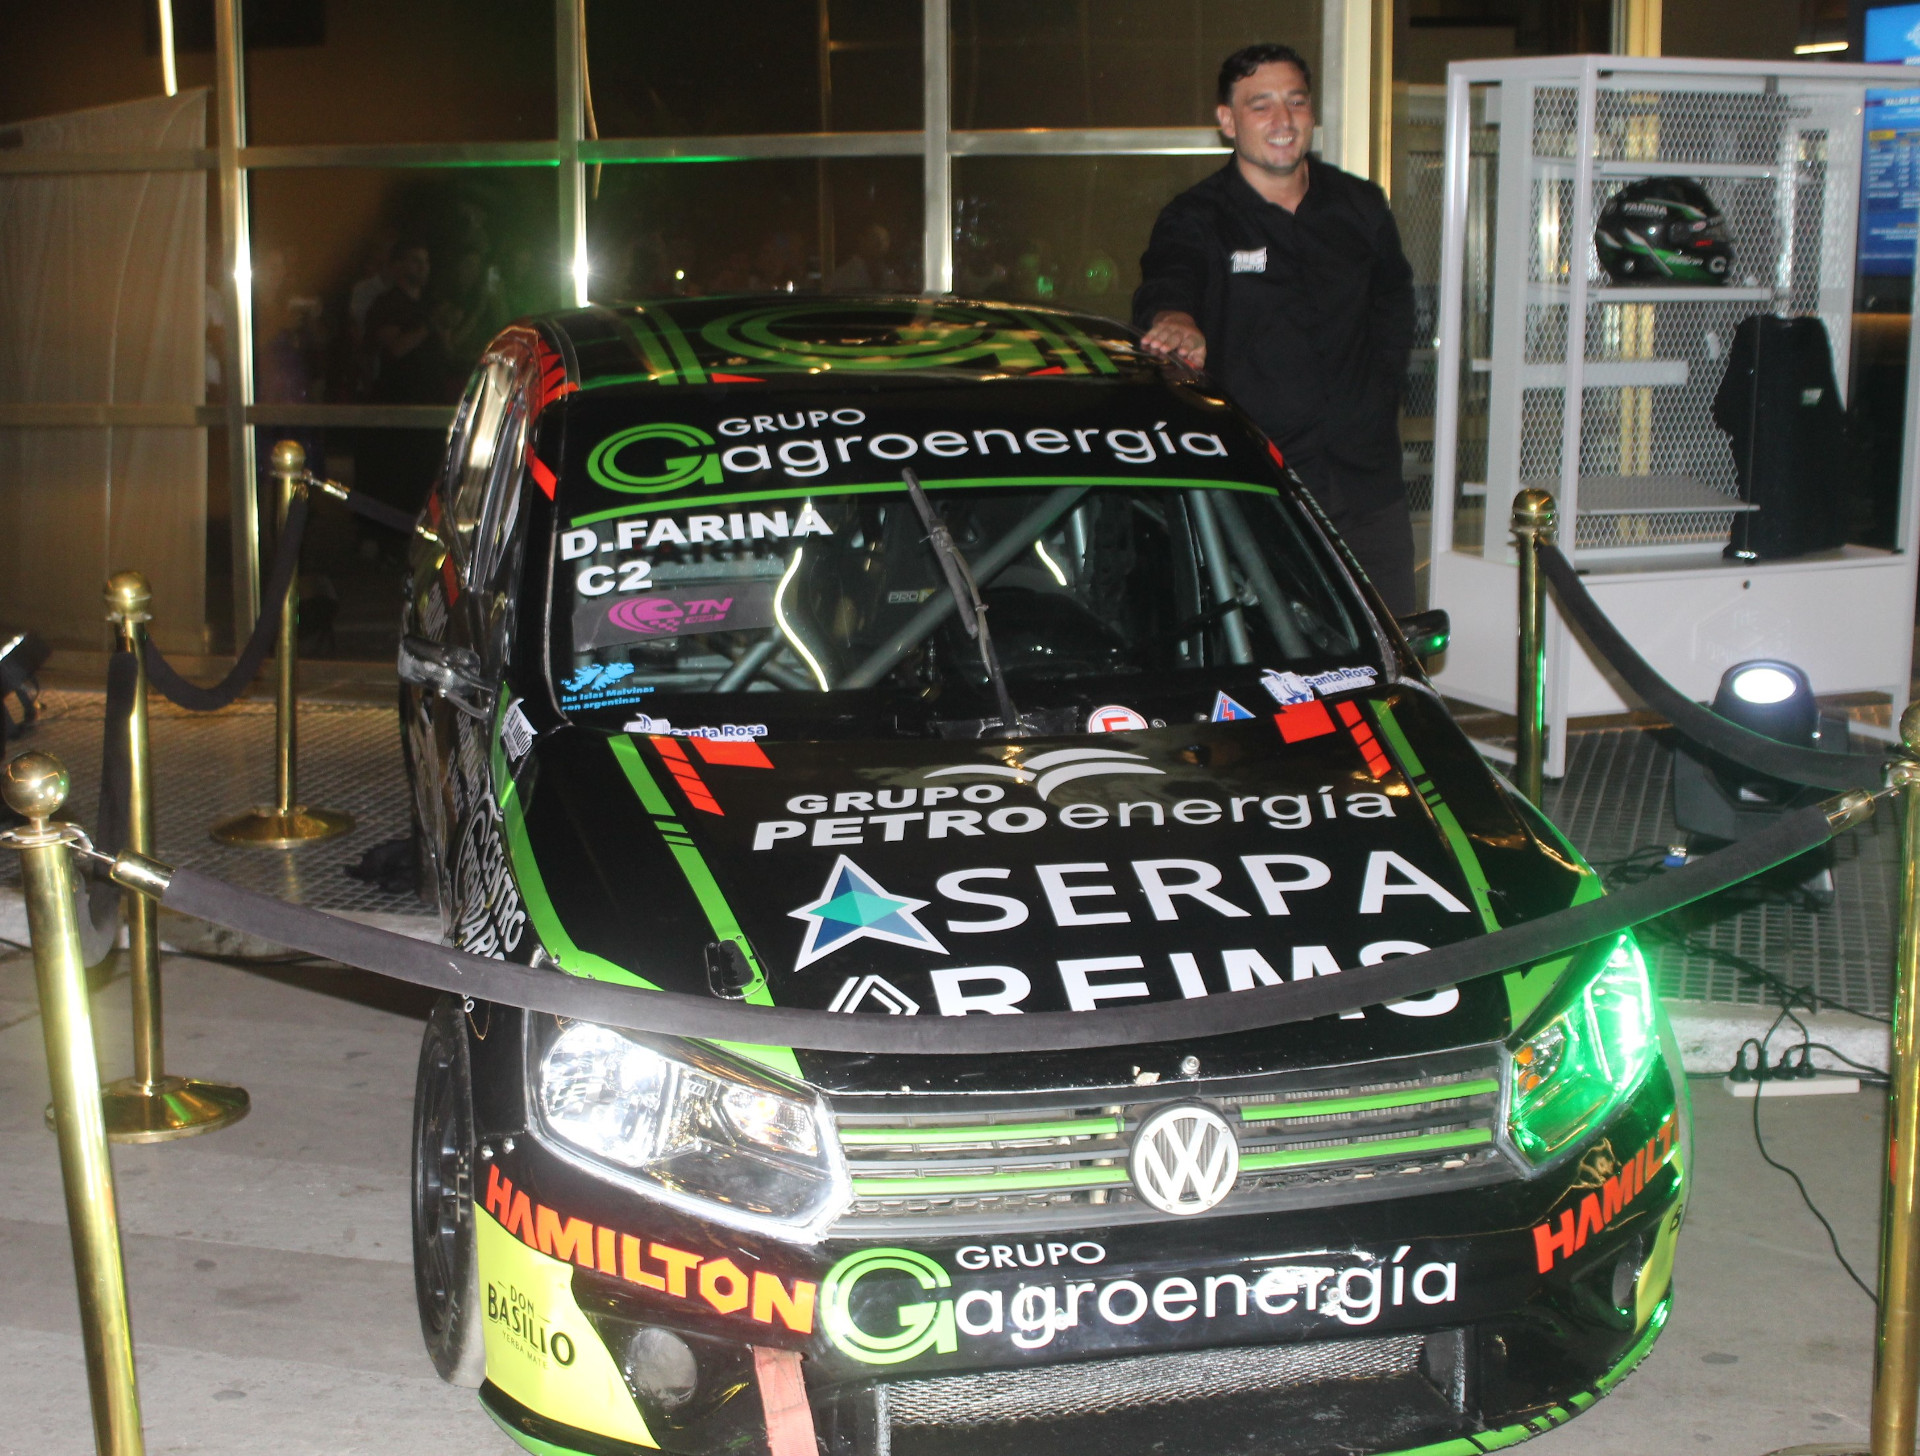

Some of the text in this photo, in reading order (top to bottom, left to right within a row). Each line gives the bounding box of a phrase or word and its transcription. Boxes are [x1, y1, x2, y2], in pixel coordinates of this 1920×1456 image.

[718, 408, 866, 437] GRUPO
[722, 421, 1228, 478] agroenergía
[560, 509, 834, 560] D.FARINA
[577, 560, 653, 598] C2
[606, 686, 654, 698] Malvinas
[1304, 667, 1377, 687] Santa Rosa
[583, 696, 641, 710] argentinas
[723, 725, 766, 737] Rosa
[785, 784, 1006, 815] GRUPO
[482, 830, 526, 953] CENTRO
[937, 850, 1471, 934] SERPA
[1532, 1108, 1680, 1274] HAMILT
[486, 1165, 817, 1334] HAMILTON
[955, 1240, 1106, 1270] GRUPO
[510, 1284, 535, 1319] DON
[955, 1245, 1458, 1350] agroenergía
[488, 1282, 576, 1367] BASILIO
[502, 1330, 524, 1353] YERBA
